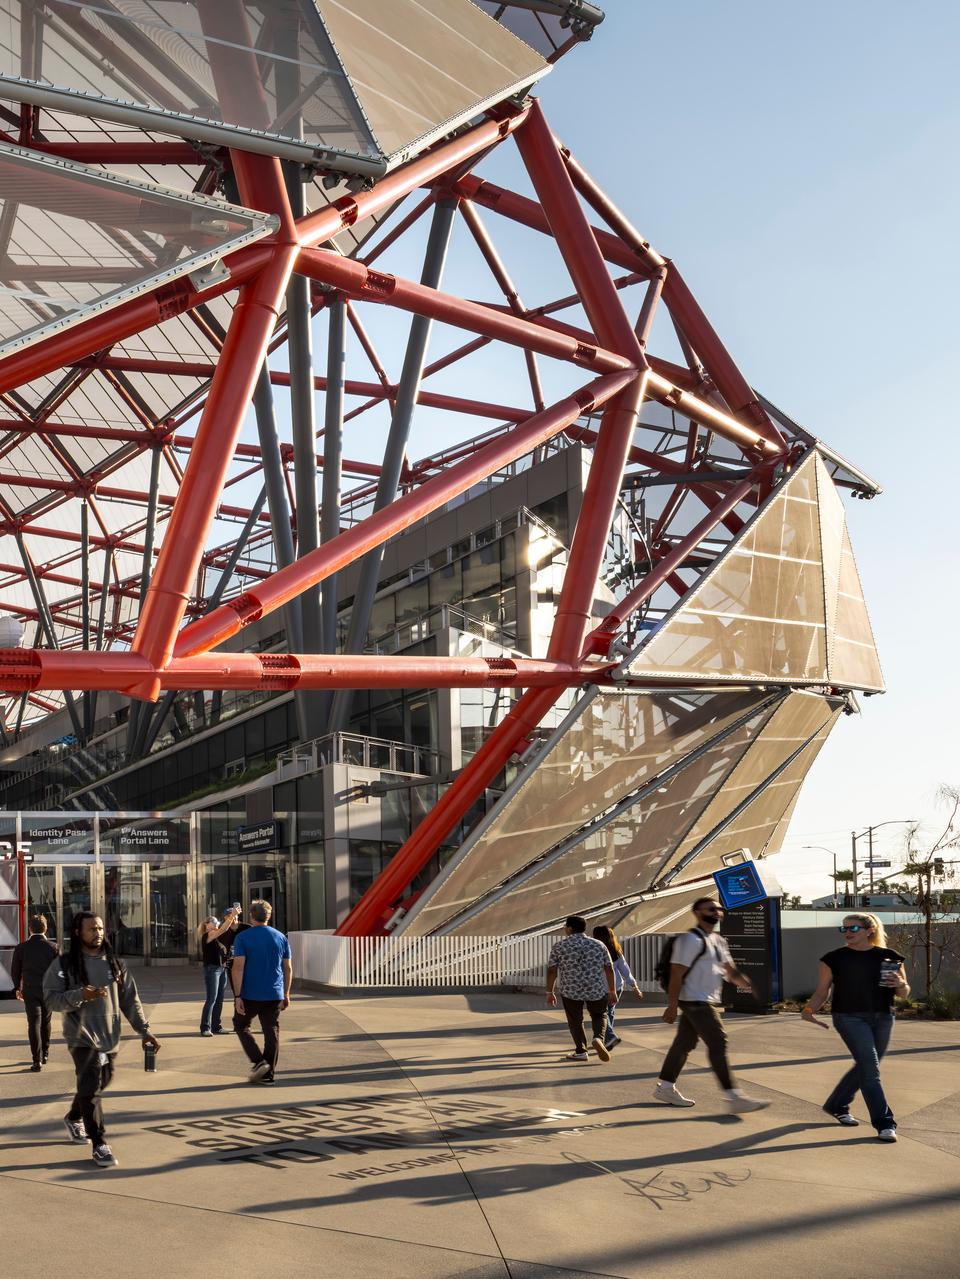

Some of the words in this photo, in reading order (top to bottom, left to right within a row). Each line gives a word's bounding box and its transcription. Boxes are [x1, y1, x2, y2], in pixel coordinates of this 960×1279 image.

[29, 828, 63, 838] Identity
[65, 828, 87, 837] Pass
[47, 837, 69, 845] Lane
[120, 837, 147, 845] Portal
[148, 837, 170, 845] Lane
[130, 829, 168, 837] Answers
[140, 1106, 332, 1138] FROM
[184, 1114, 406, 1153] SUPER
[385, 1099, 508, 1120] FAN
[217, 1148, 336, 1170] TO
[327, 1152, 467, 1182] WELCOME
